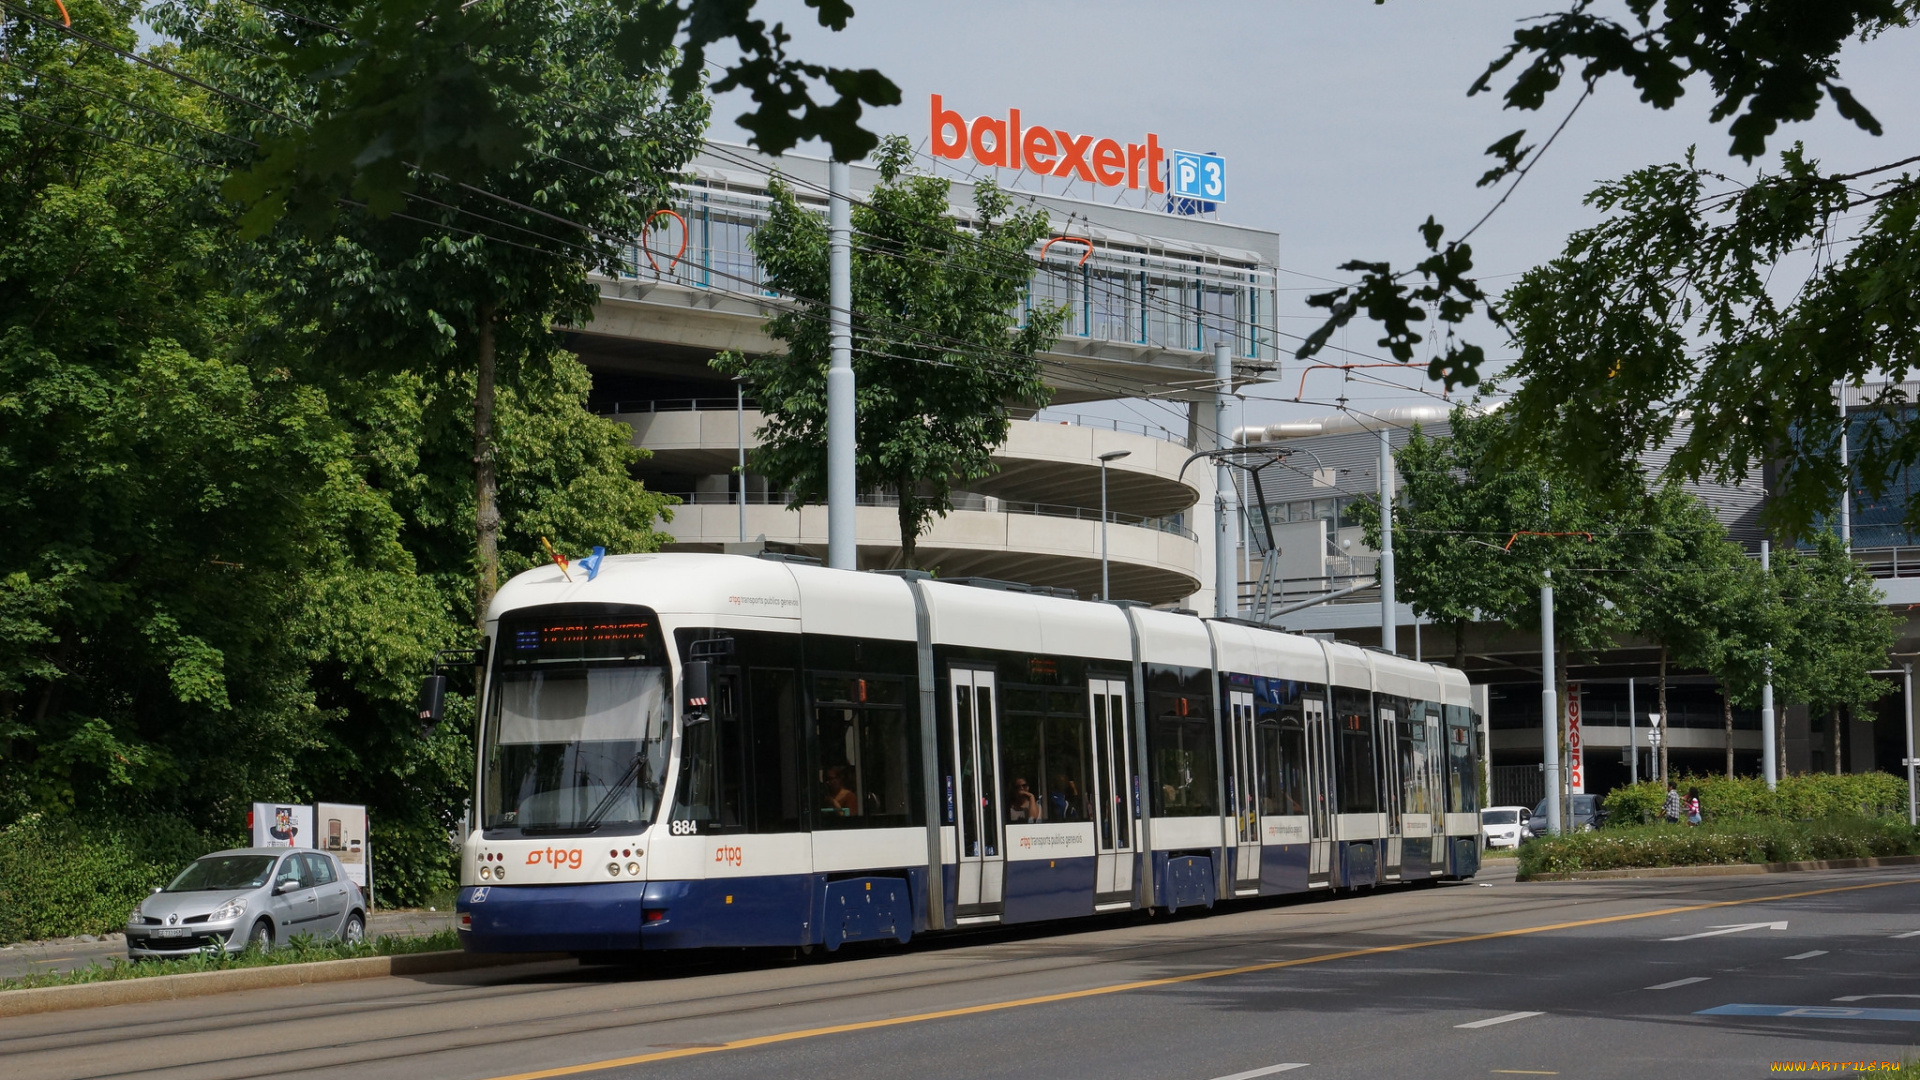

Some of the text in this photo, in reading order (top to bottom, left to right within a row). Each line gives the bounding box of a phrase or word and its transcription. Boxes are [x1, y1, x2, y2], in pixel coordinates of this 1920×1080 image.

[929, 93, 1165, 195] balexert
[1204, 161, 1222, 196] 3
[672, 820, 697, 835] 884
